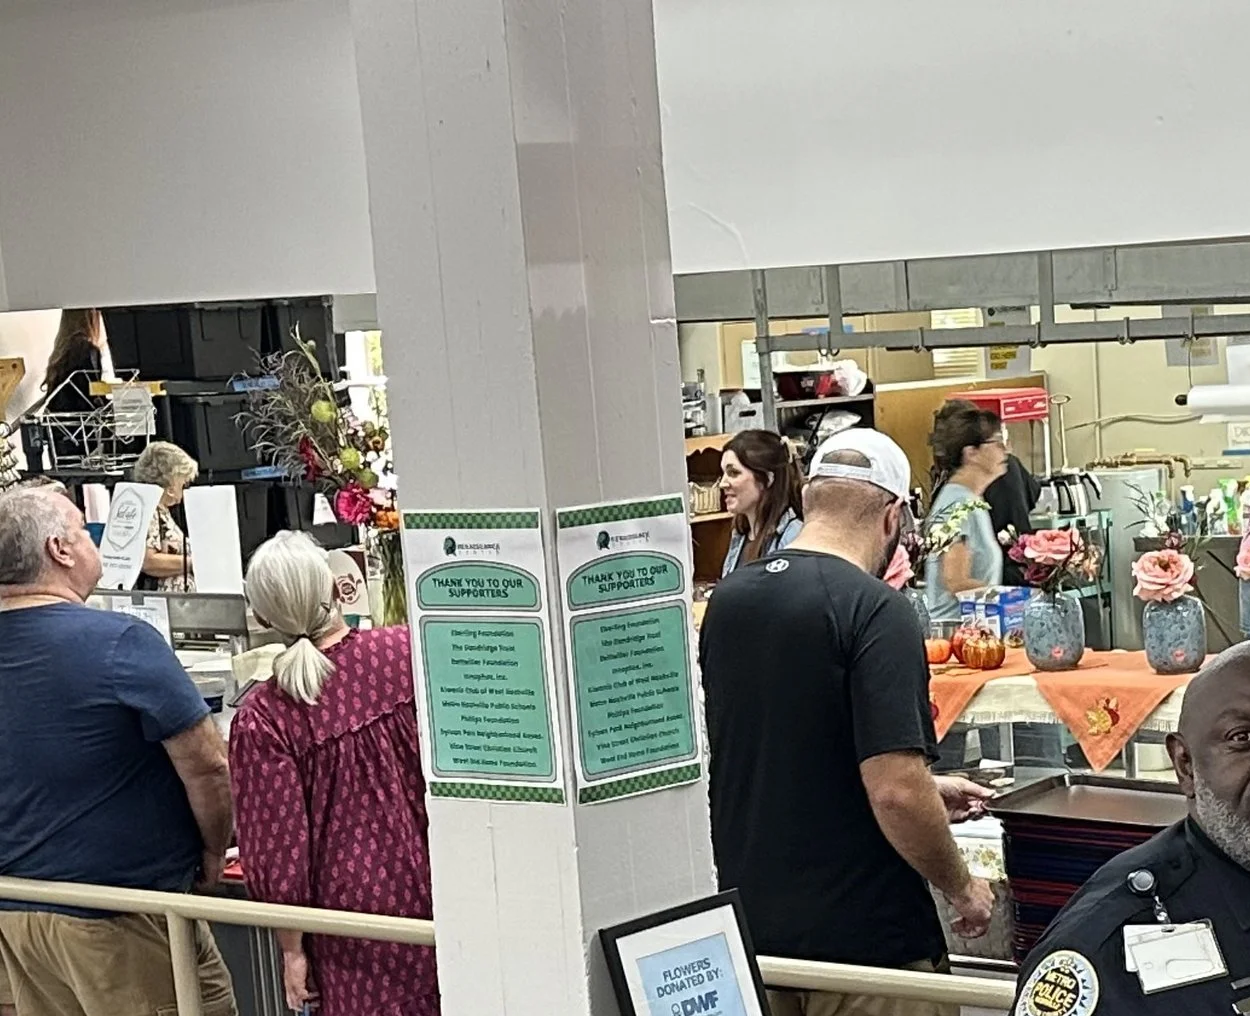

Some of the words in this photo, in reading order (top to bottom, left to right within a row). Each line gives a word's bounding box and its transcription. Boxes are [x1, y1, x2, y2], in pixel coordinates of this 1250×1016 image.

[432, 578, 462, 588] THANK
[465, 578, 485, 588] YOU
[486, 579, 499, 588] TO
[502, 579, 523, 588] OUR
[581, 571, 614, 586] THANK
[616, 569, 635, 580] YOU
[637, 567, 648, 577] TO
[649, 564, 668, 575] OUR
[598, 576, 656, 593] SUPPORTERS
[448, 588, 509, 598] SUPPORTERS
[663, 957, 711, 982] FLOWERS
[1044, 970, 1077, 990] METRO
[656, 973, 705, 998] DONATED
[706, 967, 724, 982] BY:
[1034, 981, 1077, 1009] POLICE
